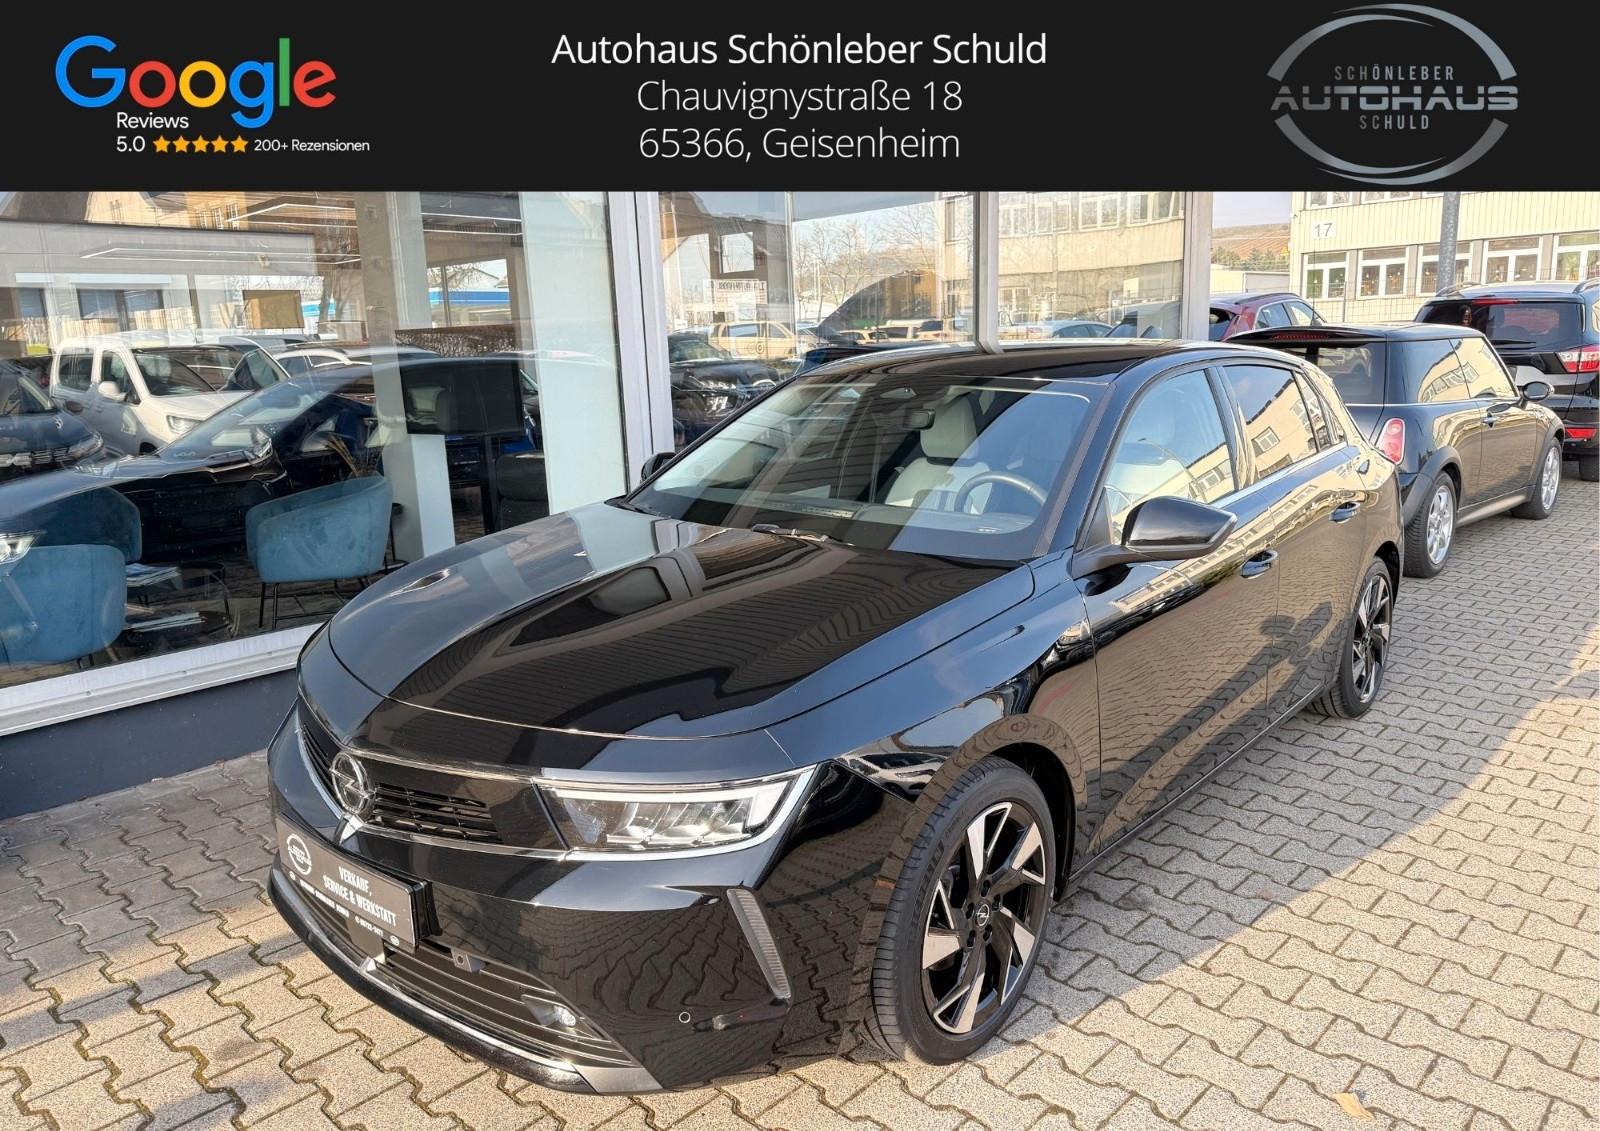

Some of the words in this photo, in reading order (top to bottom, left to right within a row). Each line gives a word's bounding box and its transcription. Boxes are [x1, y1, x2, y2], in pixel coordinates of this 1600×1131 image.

[1314, 222, 1333, 238] 17
[322, 874, 350, 901] SERVICE
[349, 889, 357, 905] &
[356, 893, 397, 927] WERKSTATT
